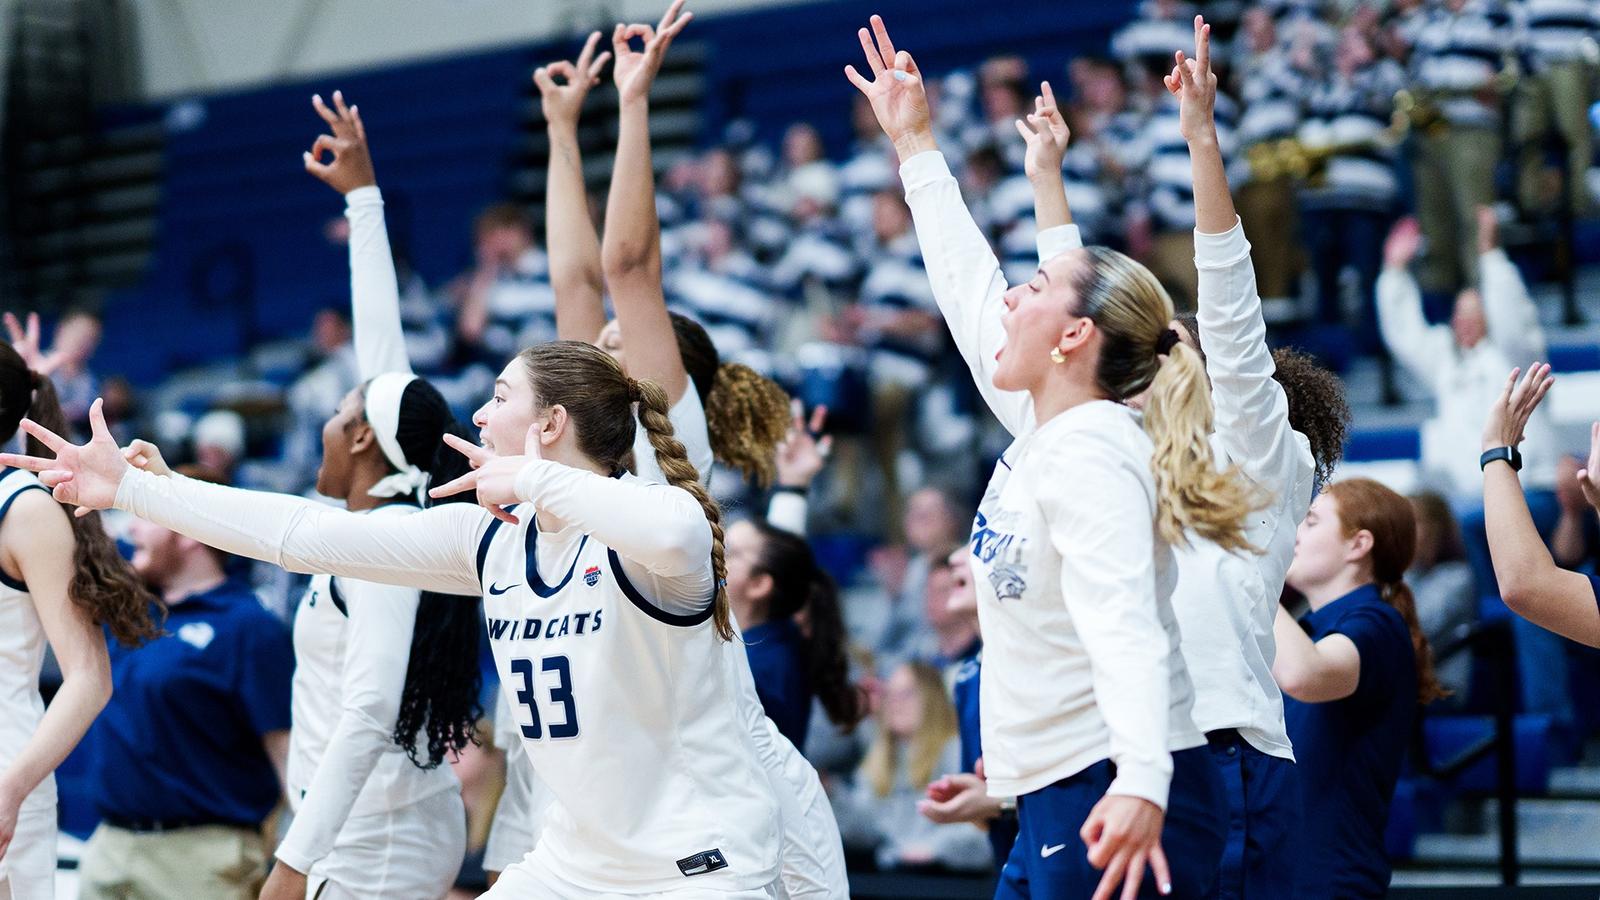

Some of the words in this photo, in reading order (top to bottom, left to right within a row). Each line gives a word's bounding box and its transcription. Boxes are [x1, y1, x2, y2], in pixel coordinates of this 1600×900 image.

[488, 608, 602, 641] WIDCATS
[510, 654, 580, 740] 33
[708, 854, 721, 864] XL
